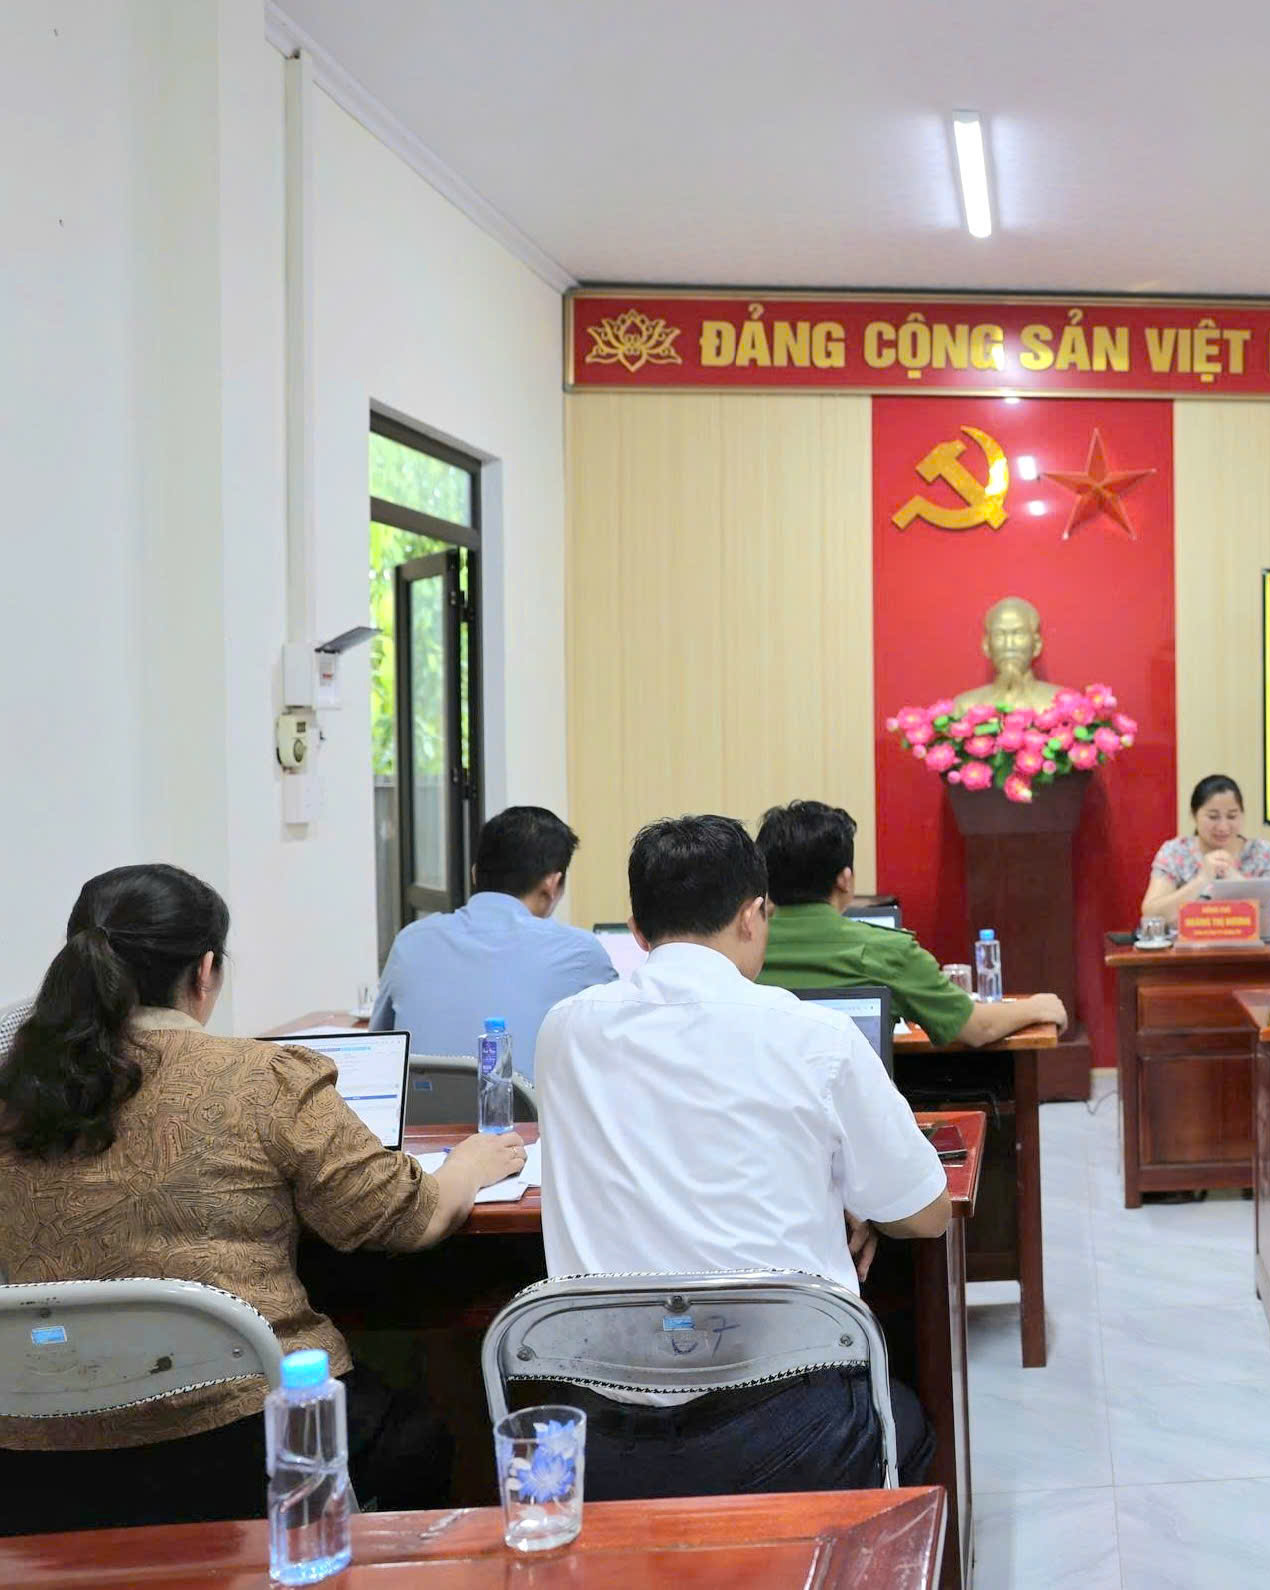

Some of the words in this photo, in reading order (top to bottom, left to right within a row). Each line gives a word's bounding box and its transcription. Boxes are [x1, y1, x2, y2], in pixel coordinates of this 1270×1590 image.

[700, 304, 846, 369] ĐẢNG
[863, 313, 1005, 379] CỘNG
[1019, 309, 1129, 372] SẢN
[1145, 320, 1251, 383] VIỆT
